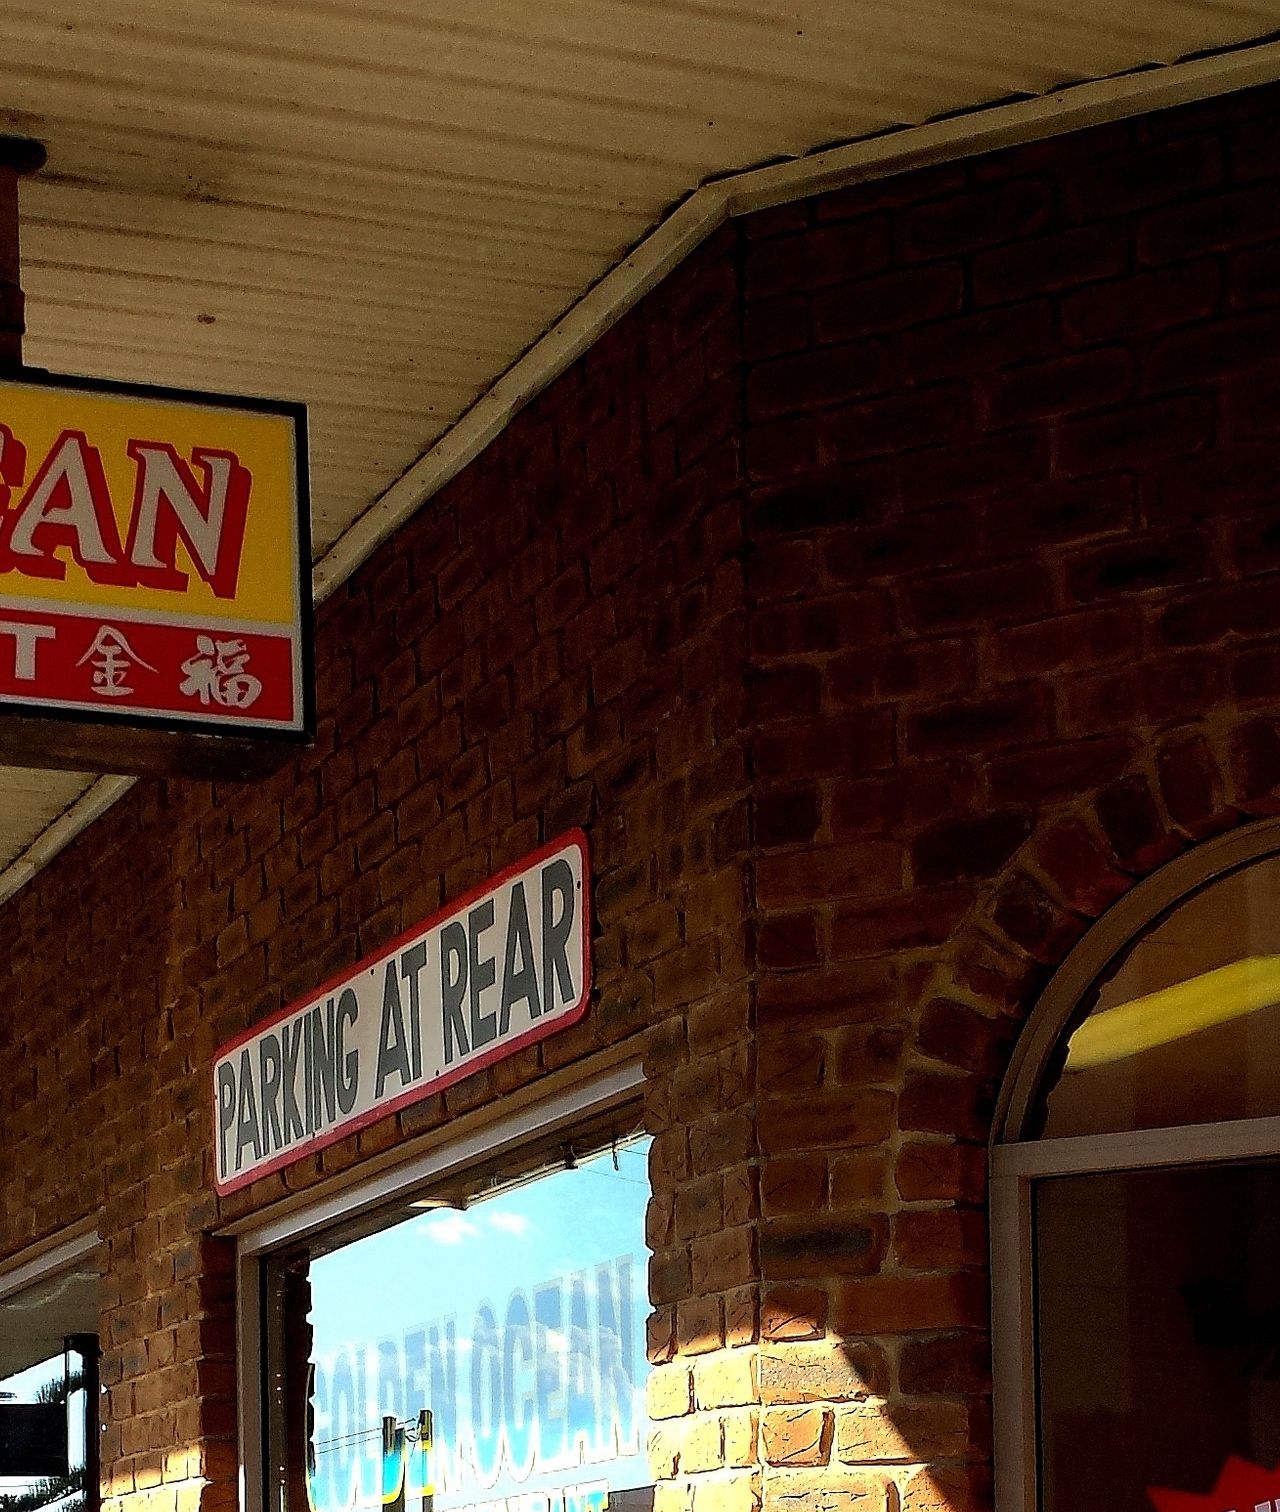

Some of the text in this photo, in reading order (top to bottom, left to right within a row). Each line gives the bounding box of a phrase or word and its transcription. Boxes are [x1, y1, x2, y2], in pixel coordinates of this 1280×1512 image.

[217, 858, 576, 1179] PARKING AT REAR
